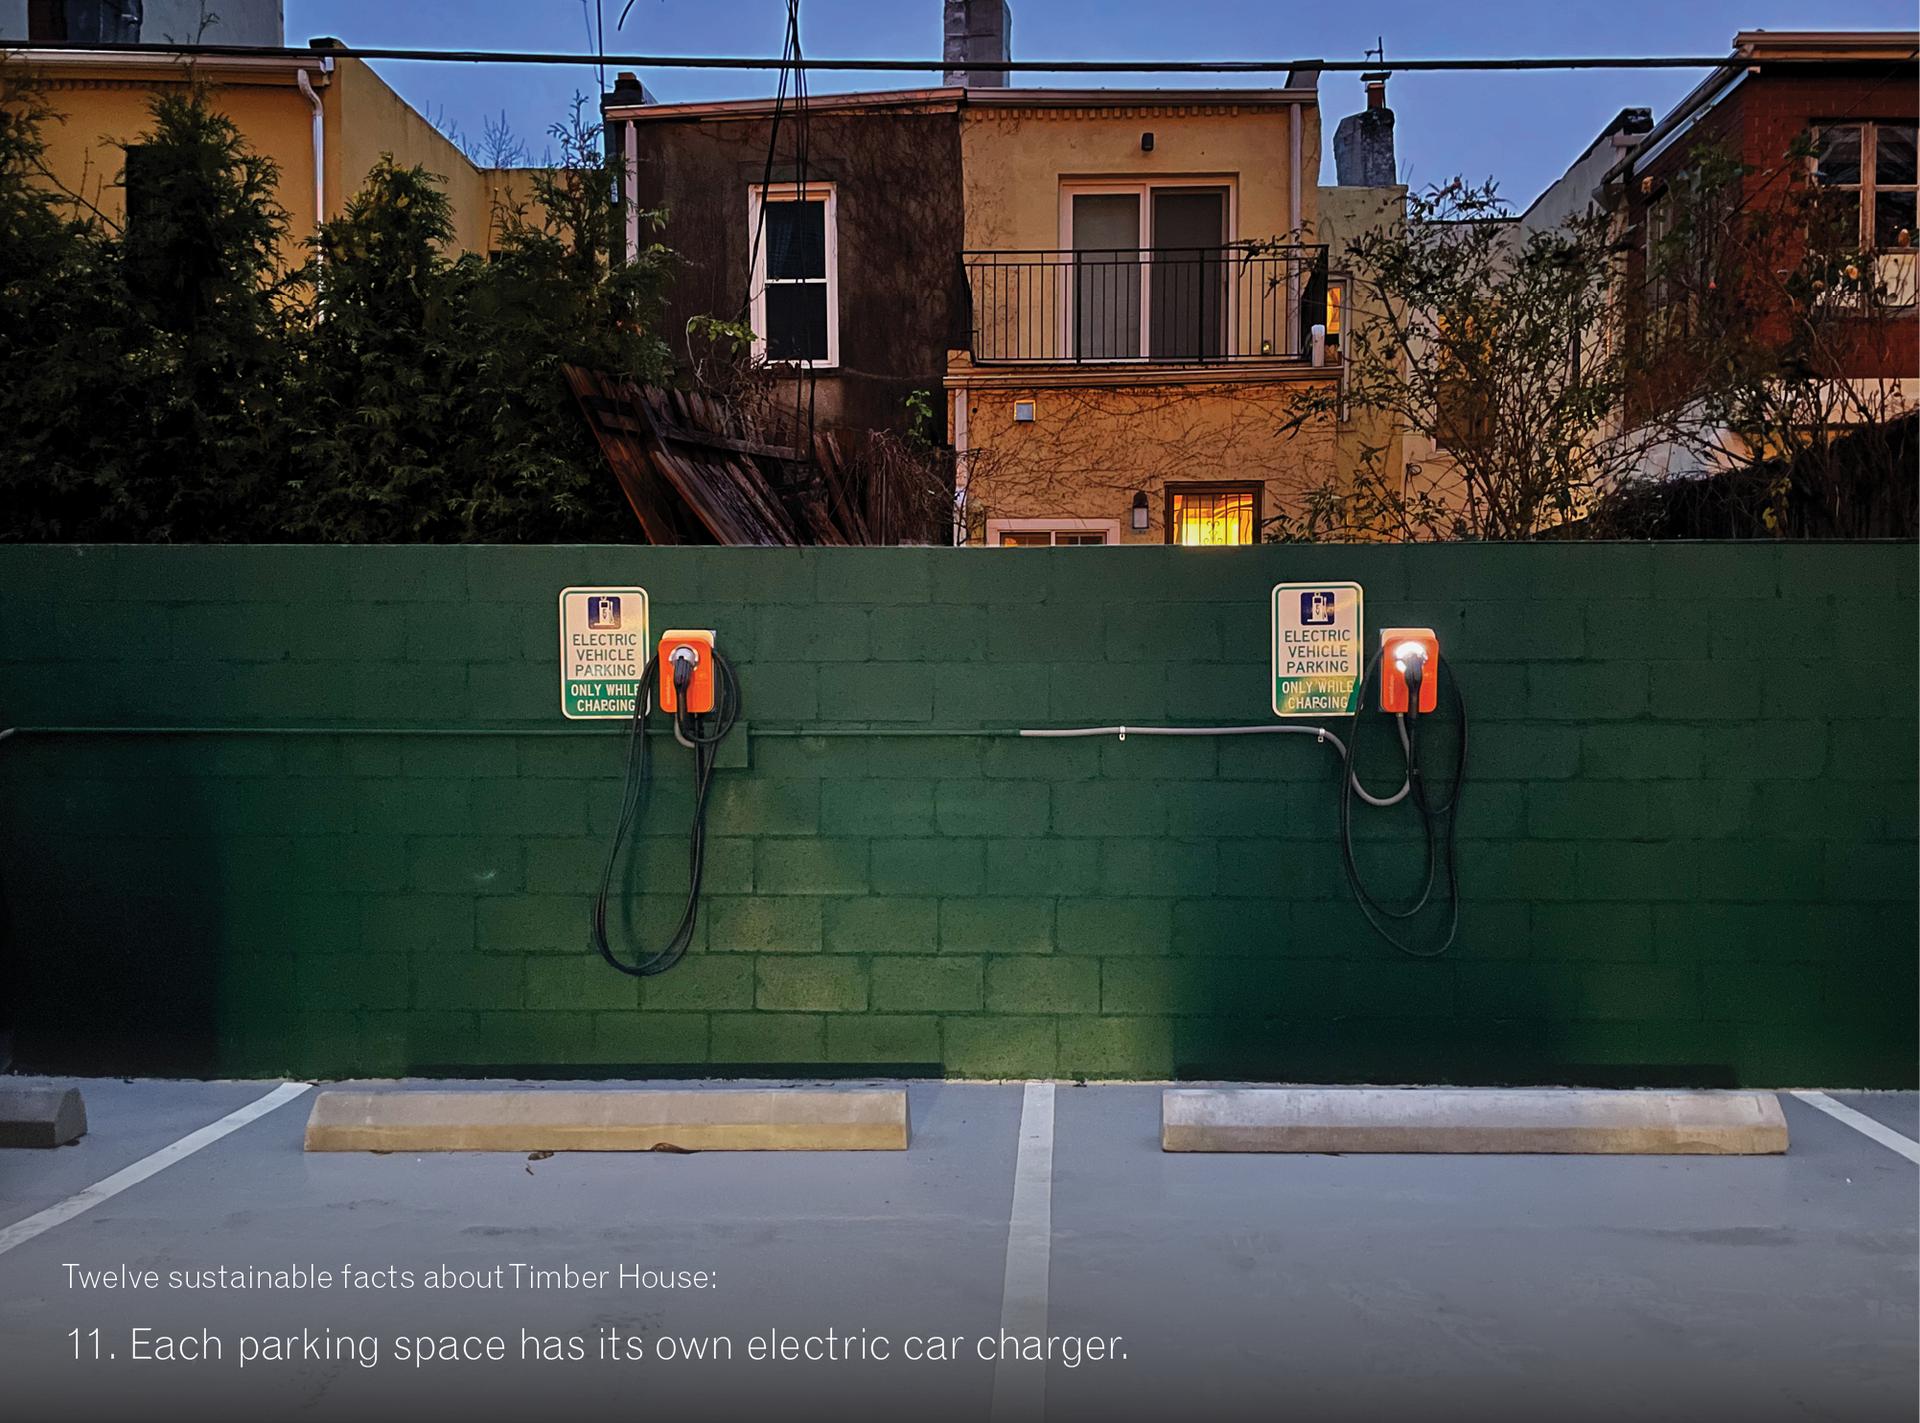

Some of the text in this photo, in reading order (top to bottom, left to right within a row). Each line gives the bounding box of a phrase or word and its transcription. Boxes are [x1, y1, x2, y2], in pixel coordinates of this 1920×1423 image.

[573, 633, 637, 646] ELECTRIC
[1284, 629, 1350, 643] ELECTRIC
[576, 649, 635, 661] VEHICLE
[1288, 645, 1348, 658] VEHICLE
[575, 664, 636, 677] PARKING
[1286, 660, 1349, 673] PARKING
[571, 683, 602, 696] ONLY
[1282, 680, 1354, 694] ONLY WHILE
[576, 699, 636, 712] CHARGING
[1288, 696, 1348, 709] CHARGING
